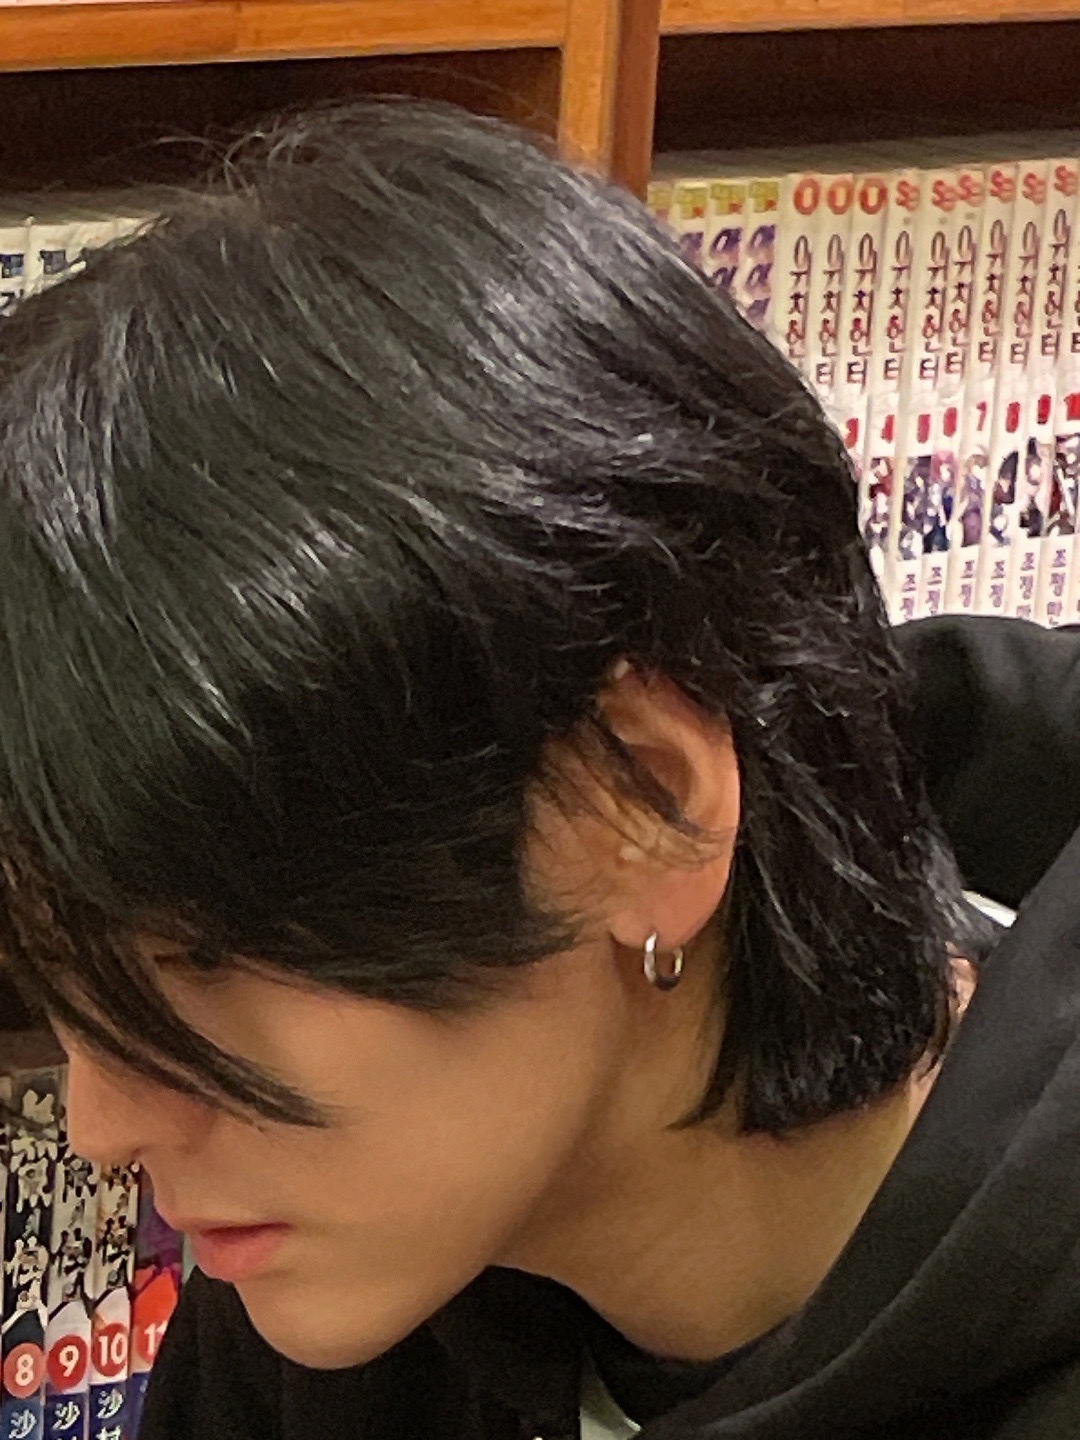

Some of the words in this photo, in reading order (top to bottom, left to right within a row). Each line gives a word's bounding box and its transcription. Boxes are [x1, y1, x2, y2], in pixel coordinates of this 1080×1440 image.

[58, 1345, 80, 1378] 9
[98, 1335, 125, 1368] 10
[15, 1353, 34, 1386] 8
